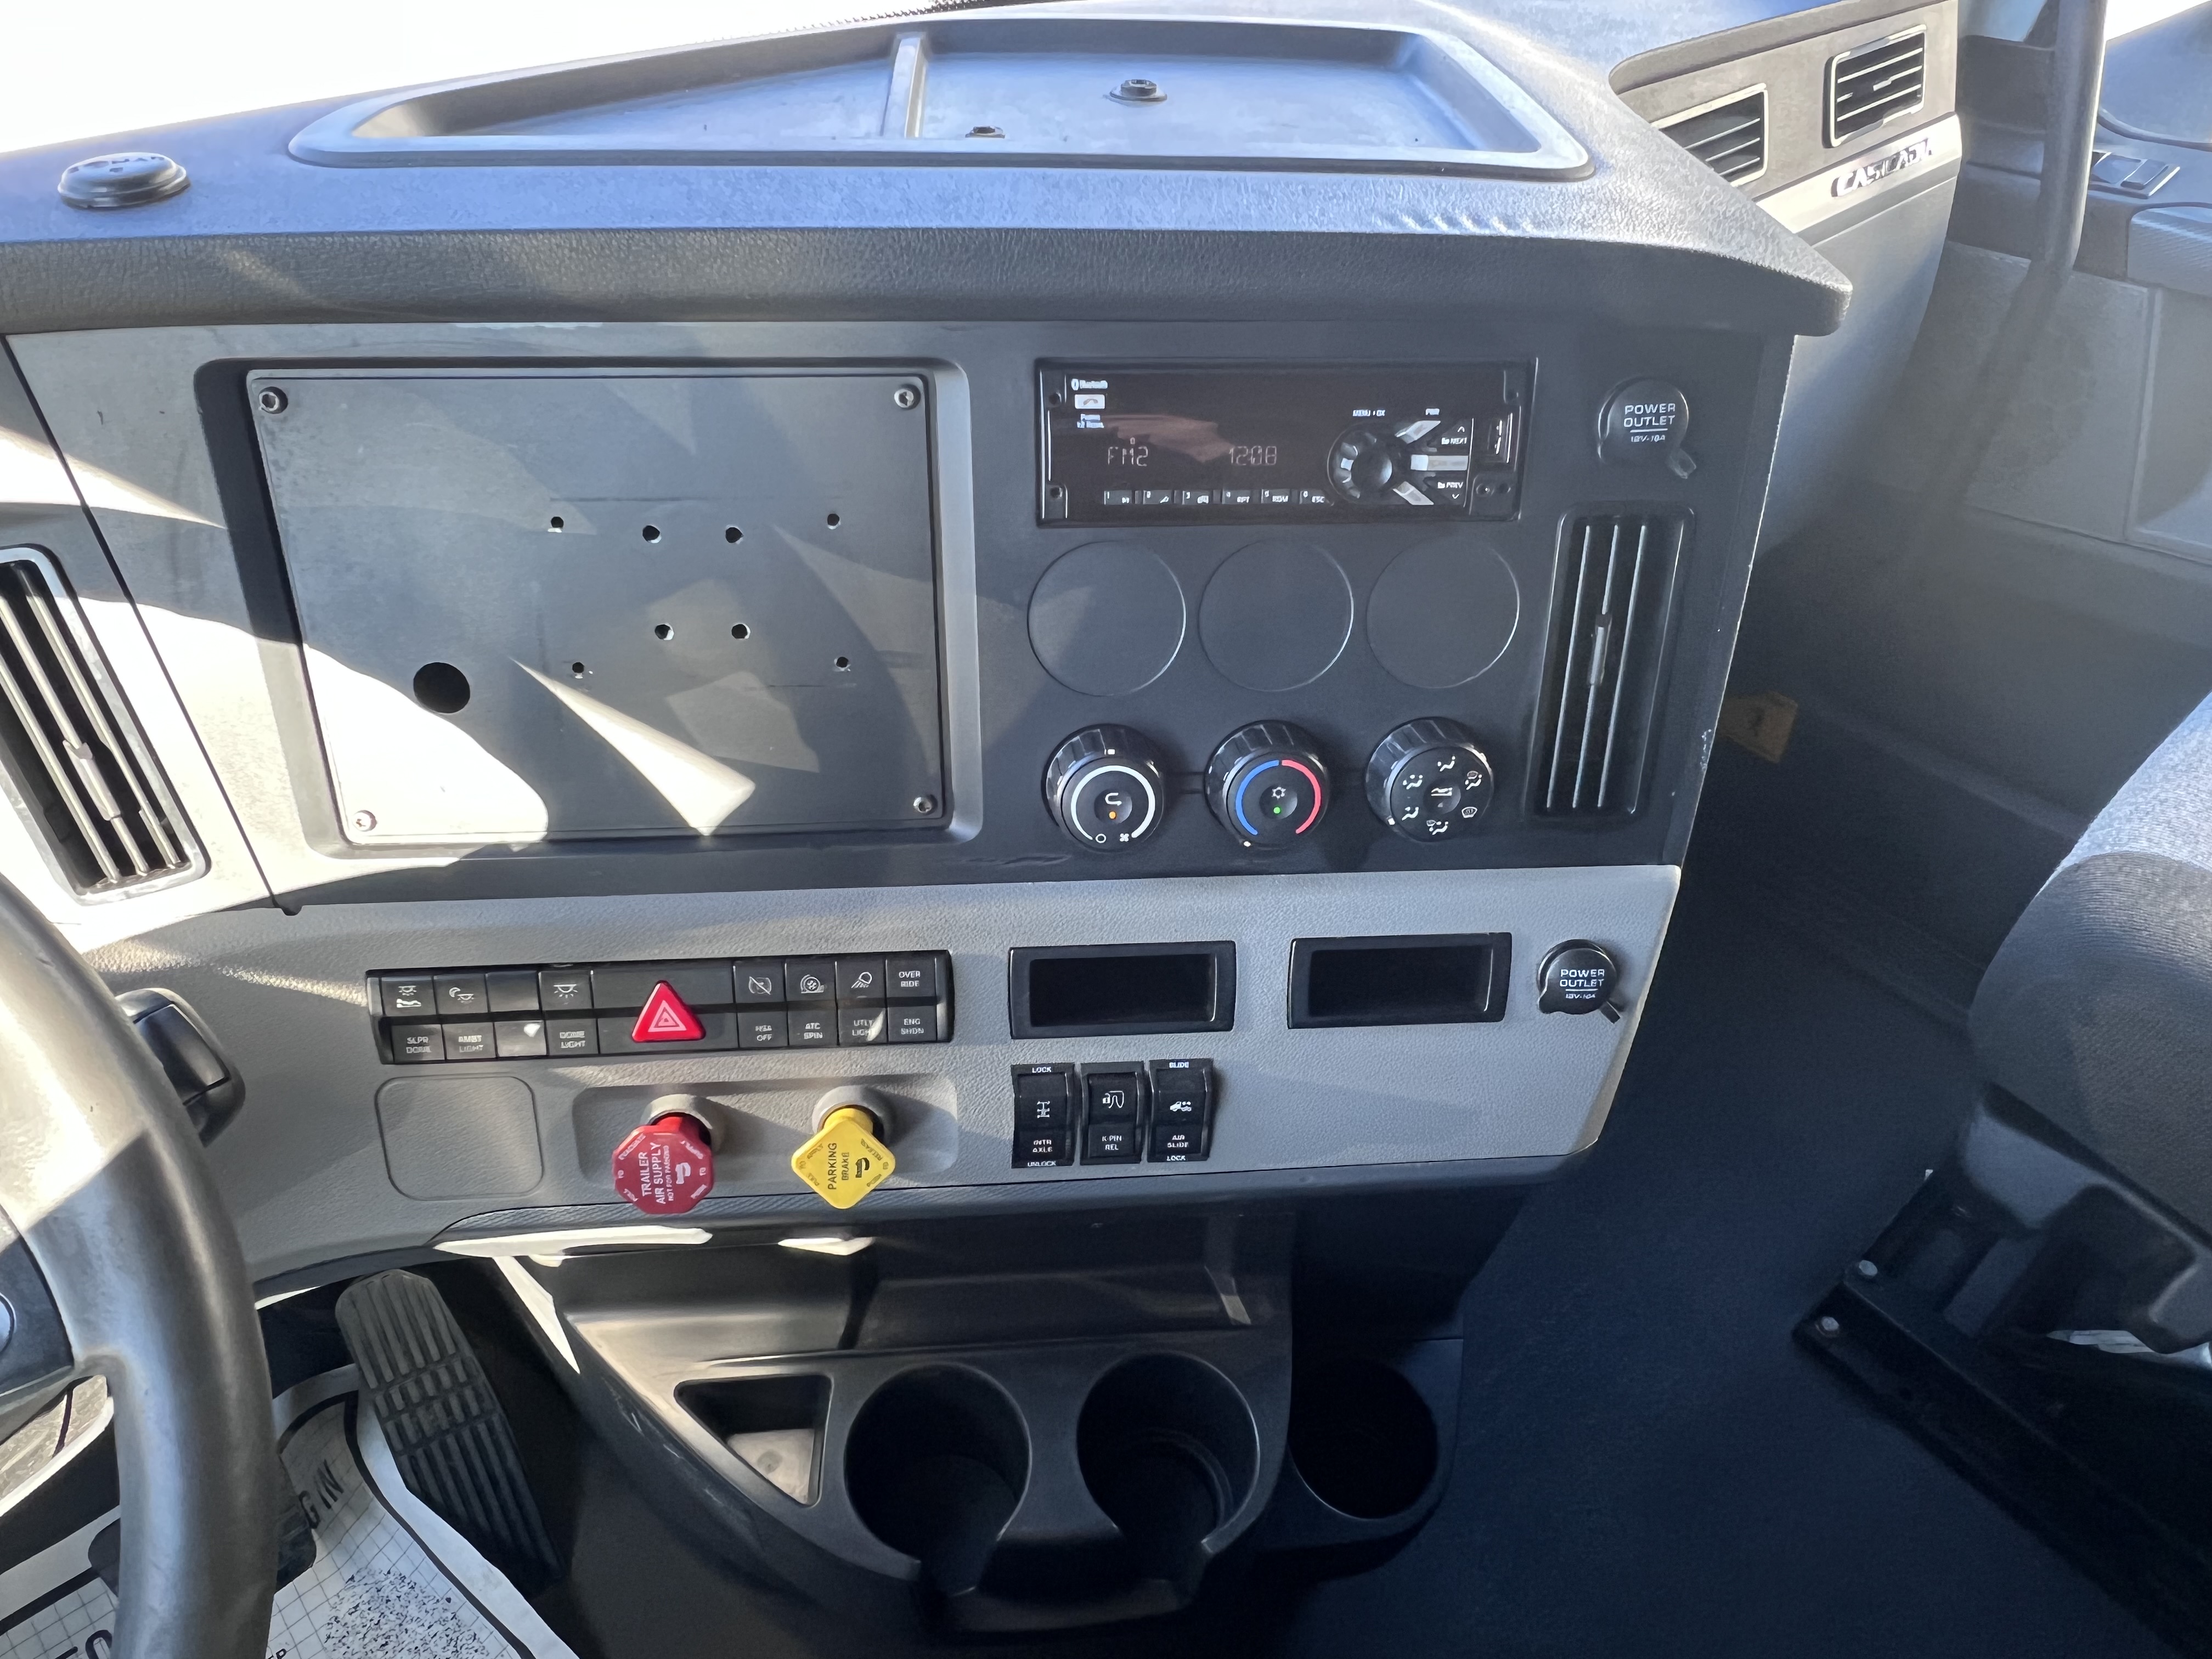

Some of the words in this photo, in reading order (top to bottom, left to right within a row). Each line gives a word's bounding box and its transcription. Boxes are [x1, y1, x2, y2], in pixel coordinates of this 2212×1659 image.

[1624, 403, 1675, 415] POWER
[1623, 415, 1675, 427] OUTLET
[1107, 446, 1148, 467] FM2
[1560, 969, 1605, 978] POWER
[1560, 979, 1605, 987] OUTLET
[650, 1142, 663, 1184] SUPPLY
[827, 1143, 837, 1190] PARKING
[841, 1152, 850, 1181] BRAKE
[638, 1152, 652, 1197] TRAILER
[655, 1188, 666, 1204] AIR
